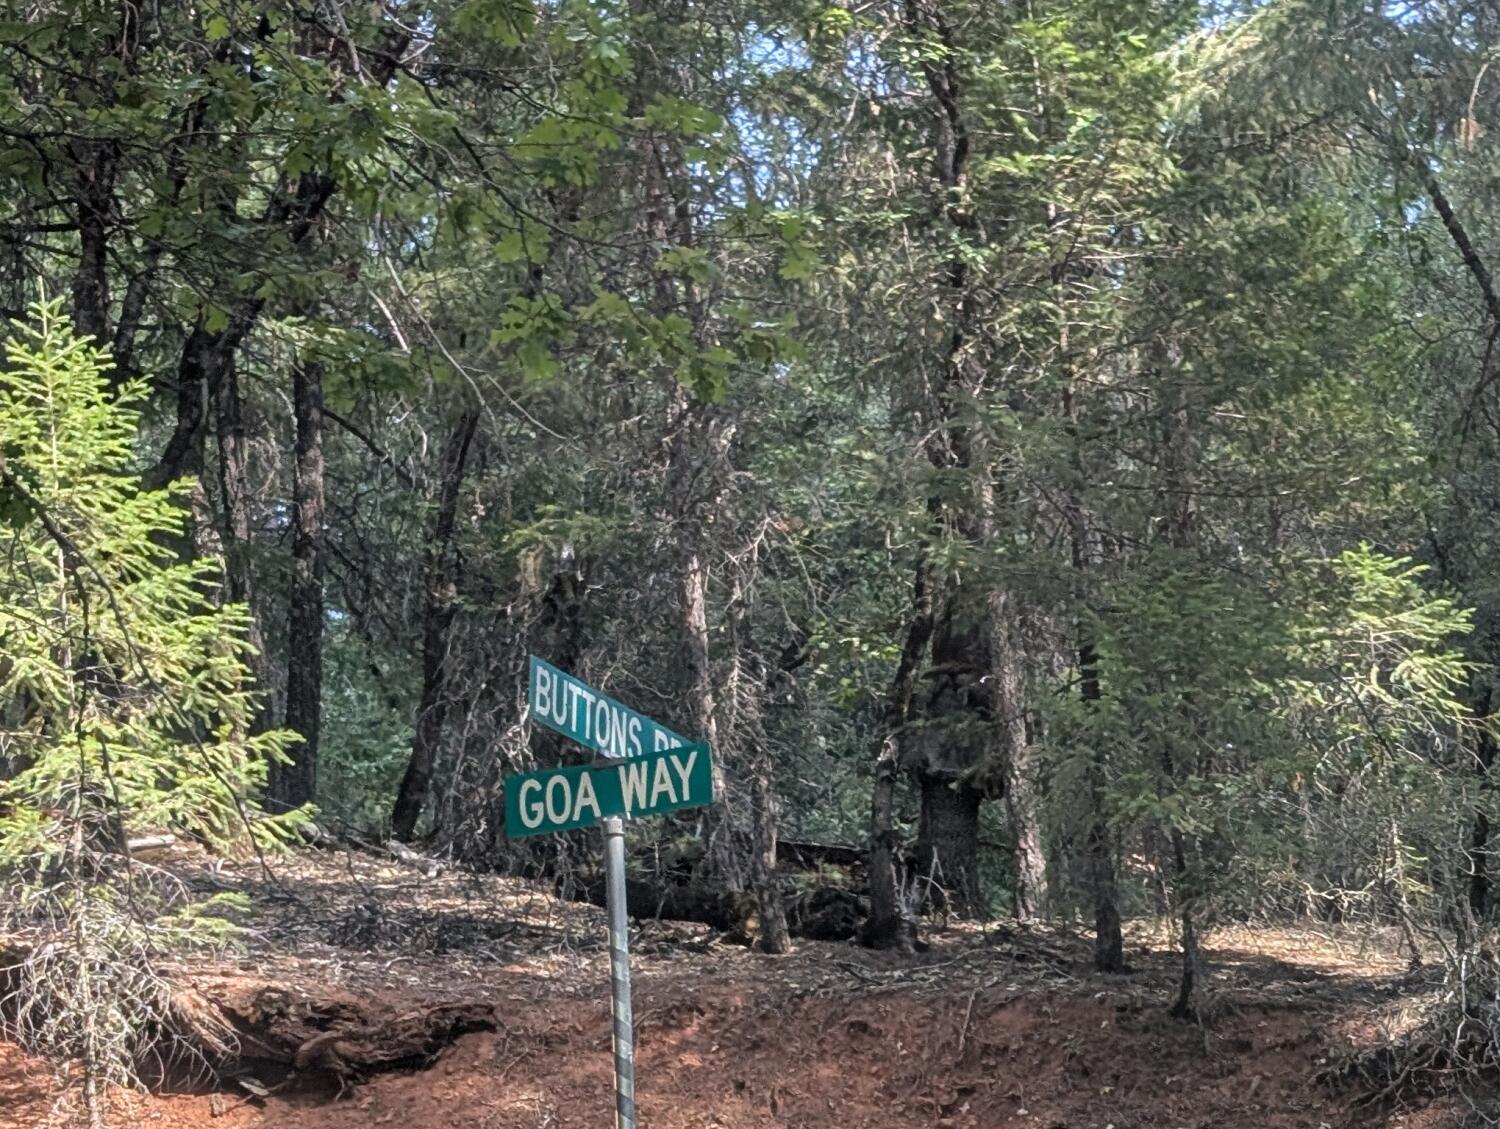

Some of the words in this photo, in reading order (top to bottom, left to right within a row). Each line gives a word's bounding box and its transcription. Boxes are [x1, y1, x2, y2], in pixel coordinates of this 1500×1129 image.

[535, 665, 643, 758] BUTTONS
[518, 771, 601, 828] GOA
[618, 751, 698, 812] WAY
